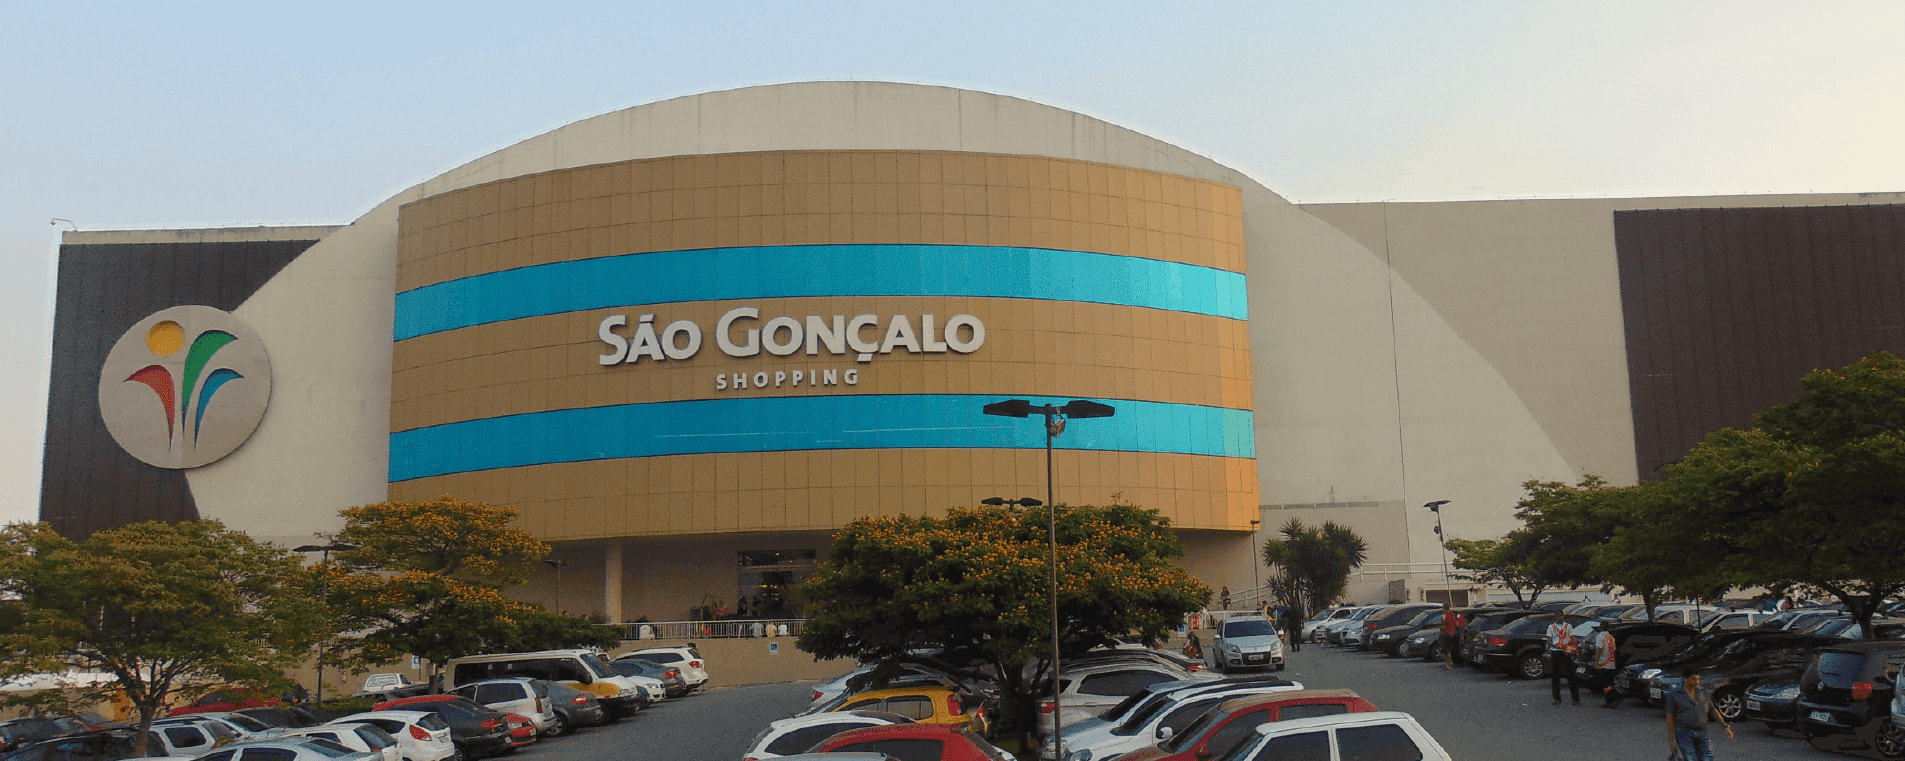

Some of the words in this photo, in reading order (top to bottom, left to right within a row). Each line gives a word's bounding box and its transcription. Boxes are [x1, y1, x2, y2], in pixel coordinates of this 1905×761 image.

[598, 313, 703, 366] SÃO
[716, 306, 986, 362] GONÇALO
[716, 368, 858, 390] SHOPPING
